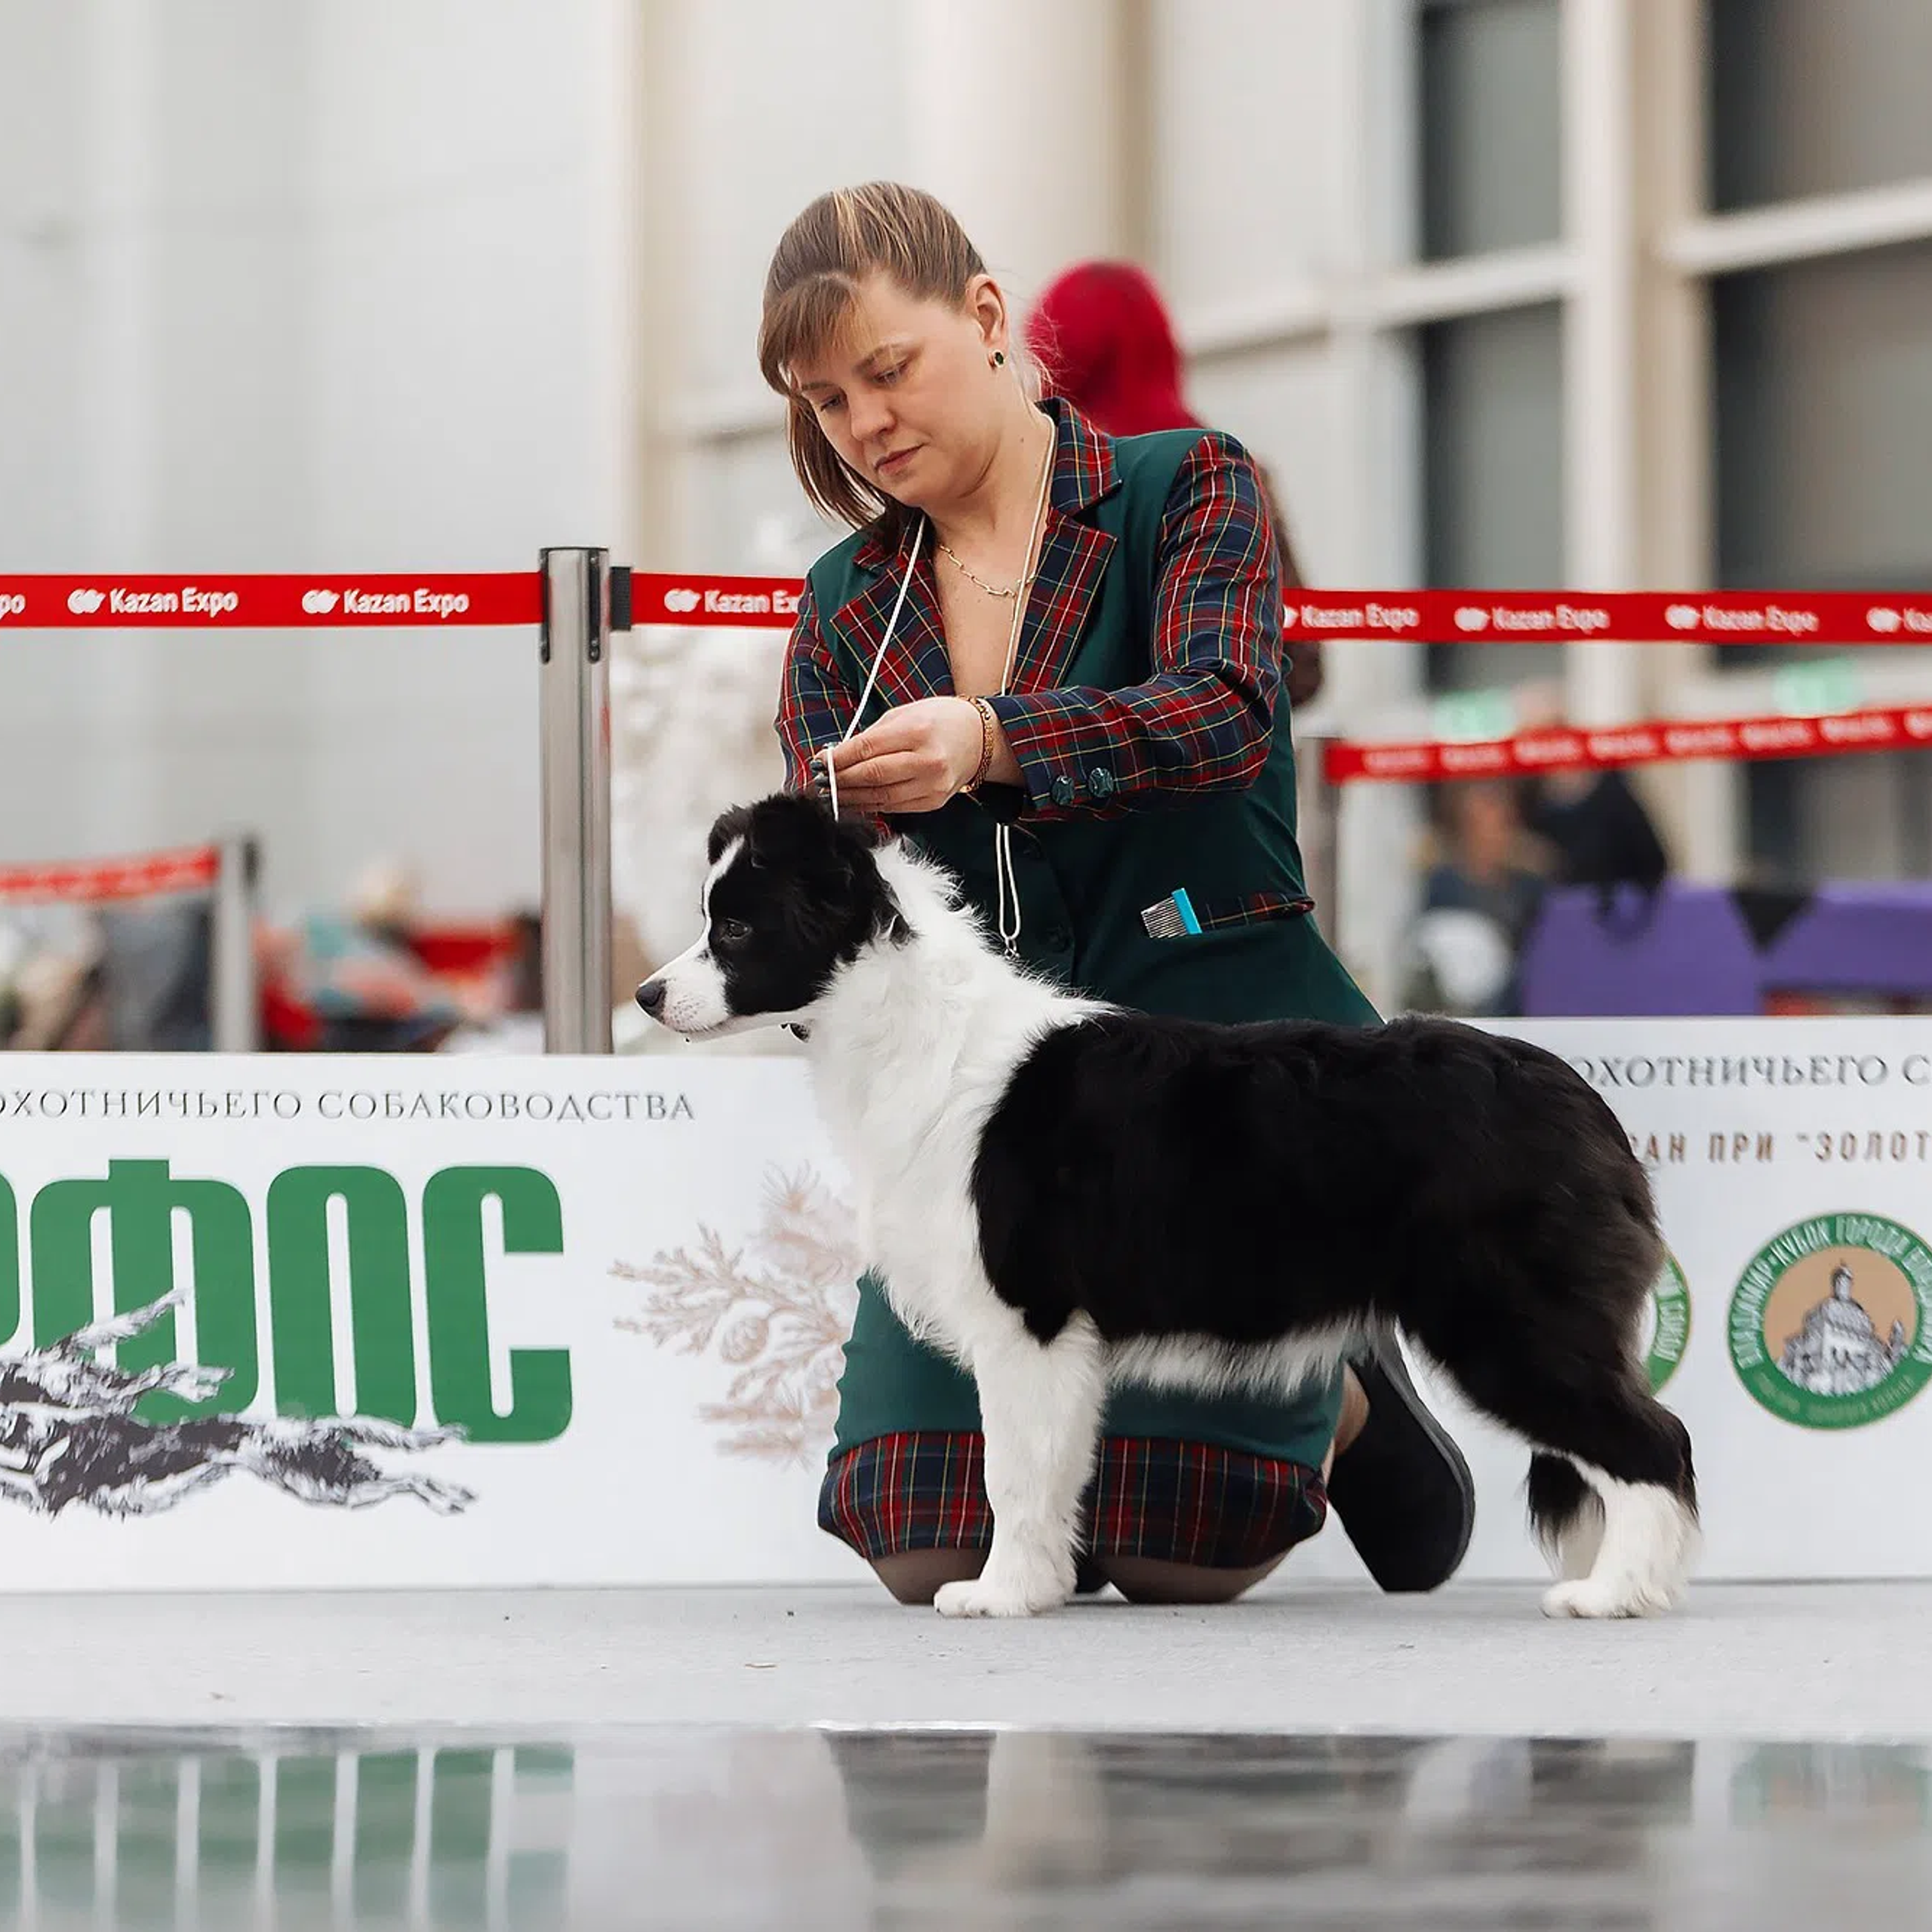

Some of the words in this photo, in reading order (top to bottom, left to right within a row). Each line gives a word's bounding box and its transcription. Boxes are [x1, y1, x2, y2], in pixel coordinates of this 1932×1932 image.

[109, 588, 179, 614] Kazan
[181, 586, 238, 618] Expo
[343, 588, 411, 614] Kazan
[414, 588, 469, 619] Expo
[704, 589, 770, 613] Kazan
[772, 589, 798, 614] Ex
[1301, 605, 1364, 629] Kazan
[1365, 603, 1420, 633] Expo
[0, 1089, 302, 1118] ХОТНИЧЬЕГО
[318, 1090, 695, 1123] СОБАКОВОДСТВА
[1709, 1132, 1774, 1162] ПРИ
[0, 1158, 573, 1443] ФОС
